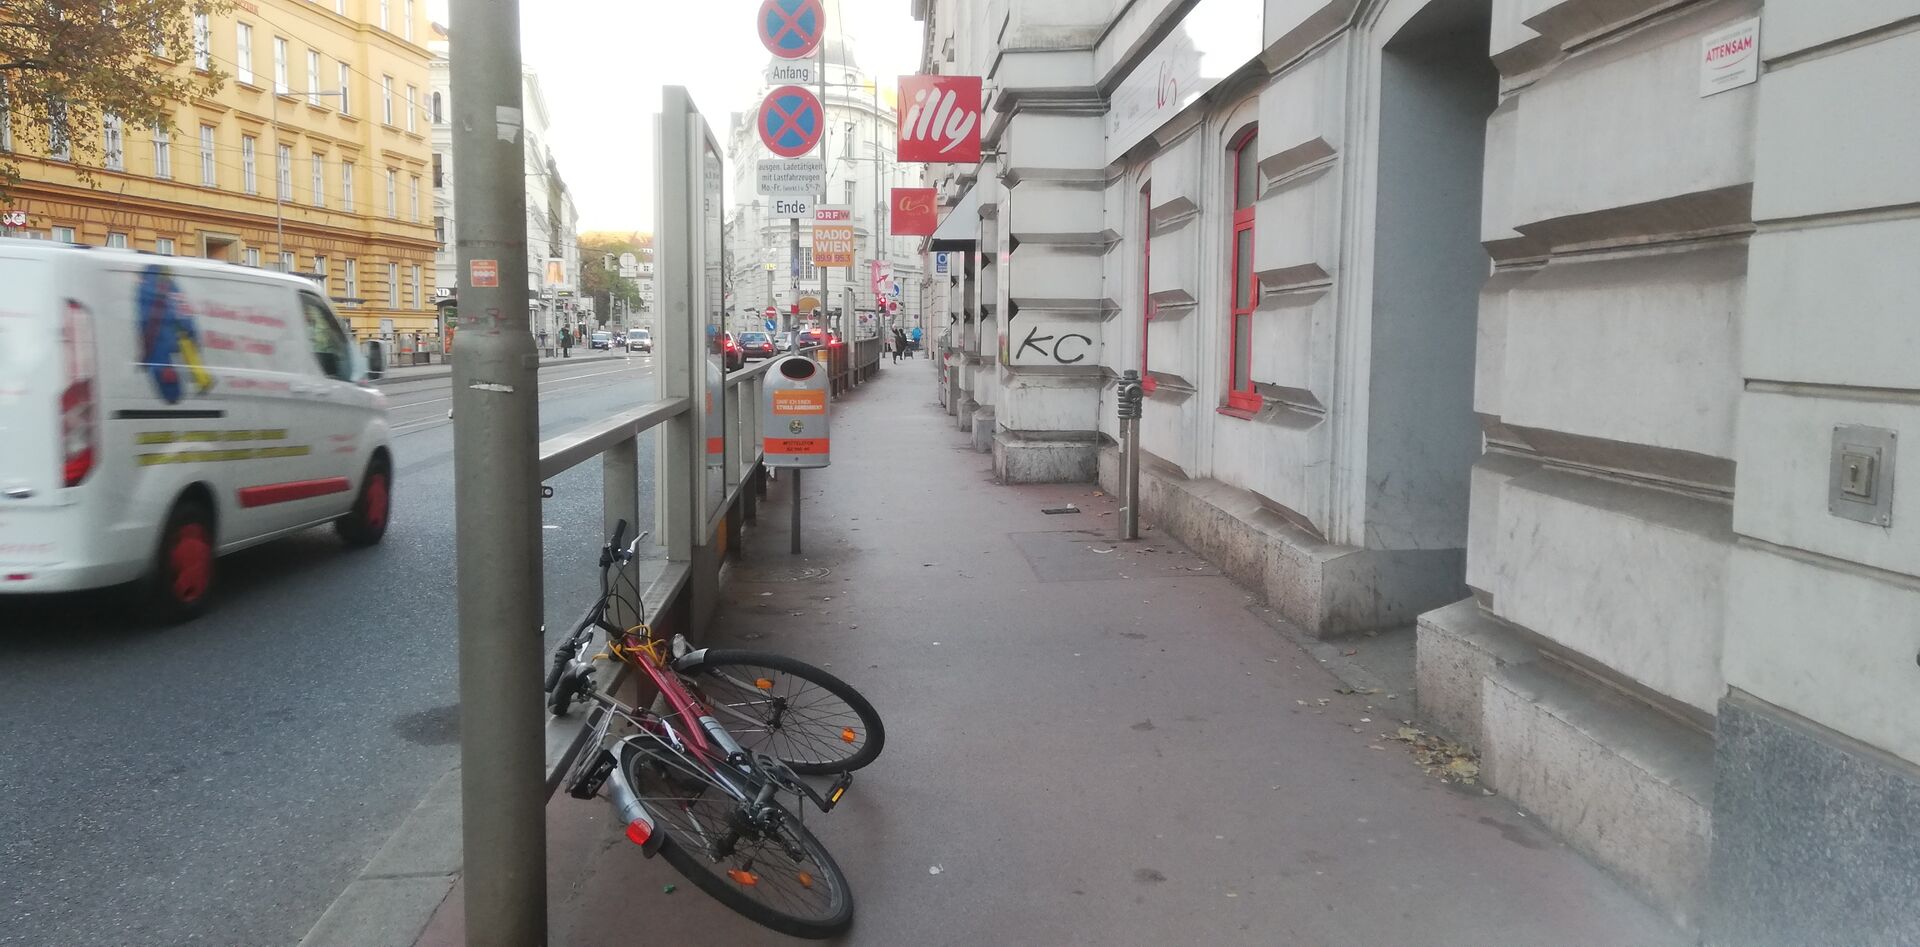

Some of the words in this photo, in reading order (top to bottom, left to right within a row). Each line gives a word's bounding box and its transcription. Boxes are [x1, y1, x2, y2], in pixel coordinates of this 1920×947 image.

[1705, 35, 1753, 64] ATTENSAM
[773, 66, 809, 81] Anfang
[903, 87, 977, 154] illy
[773, 173, 820, 182] Lastfahrzeugen
[776, 200, 806, 213] Ende
[817, 211, 839, 219] ORF
[815, 229, 852, 241] RADIO
[815, 240, 851, 253] WIEN
[1016, 326, 1092, 364] KC
